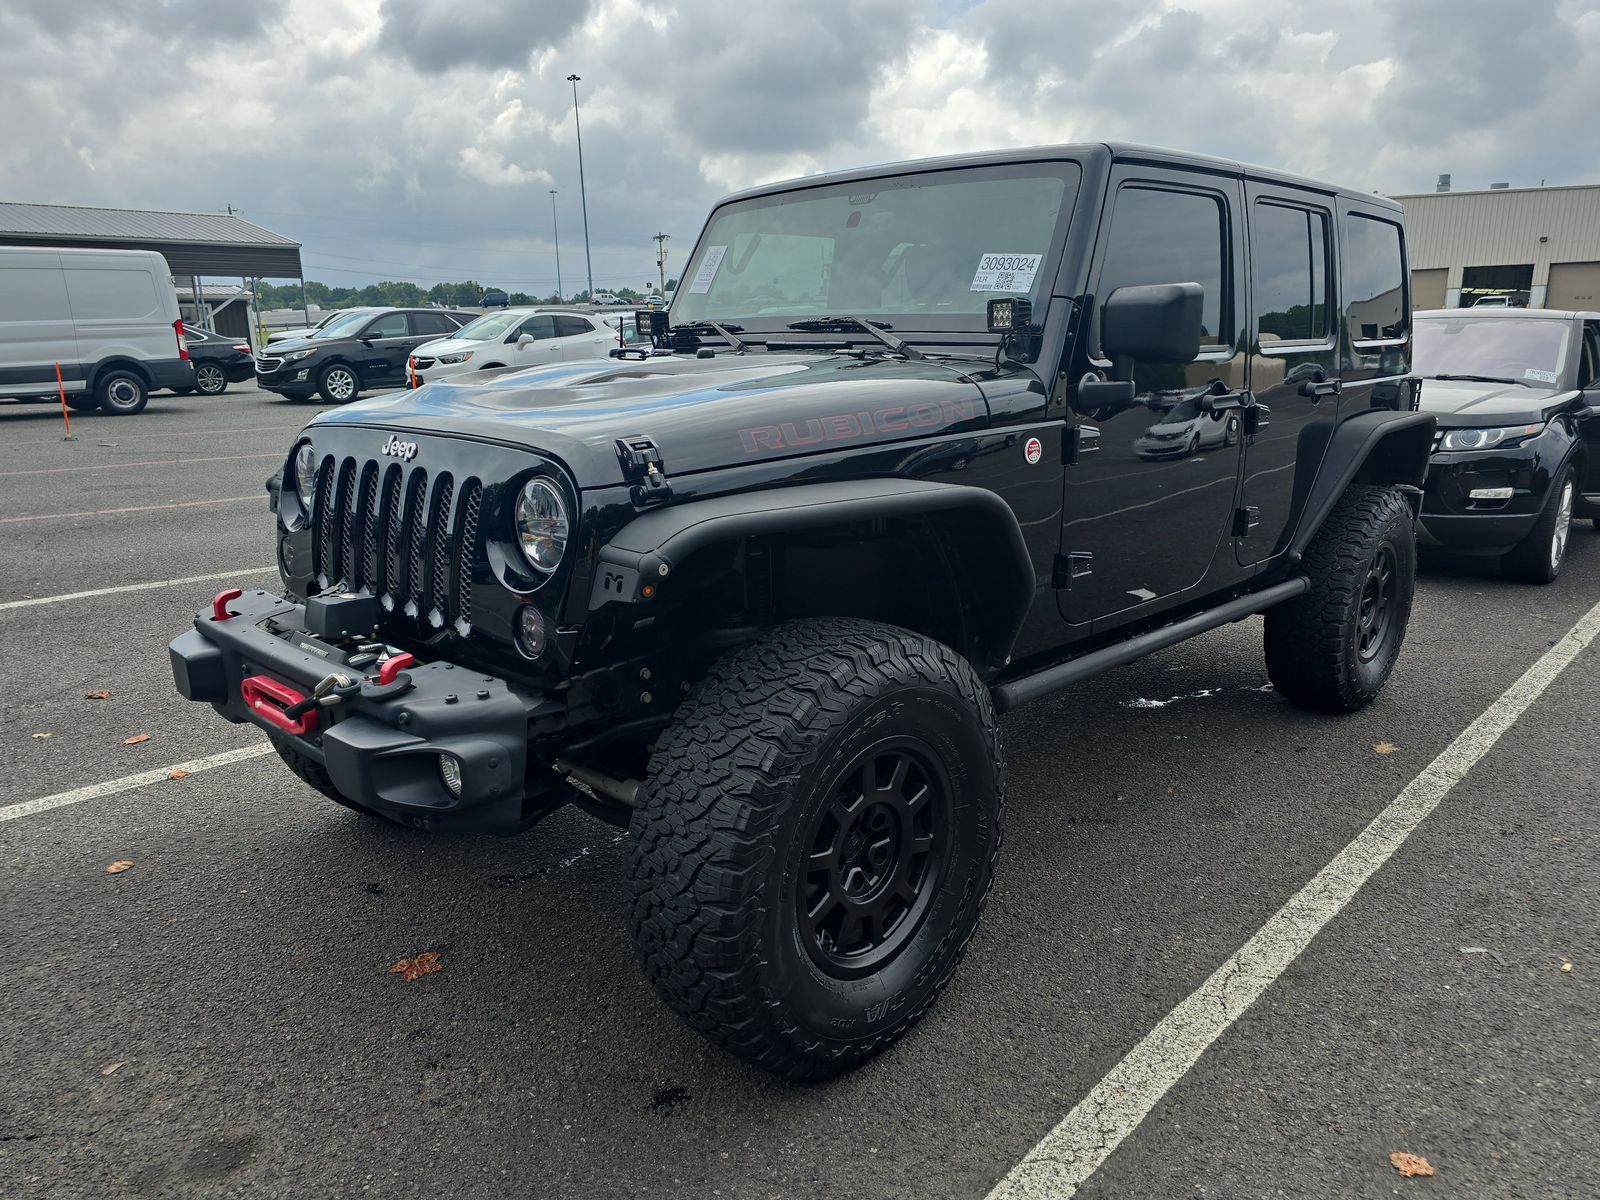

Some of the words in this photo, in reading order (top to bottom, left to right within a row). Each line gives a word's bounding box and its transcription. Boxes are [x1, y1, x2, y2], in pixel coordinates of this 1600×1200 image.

[981, 256, 1036, 271] 3093024
[736, 397, 977, 453] RUBICON
[381, 434, 418, 462] Jeep
